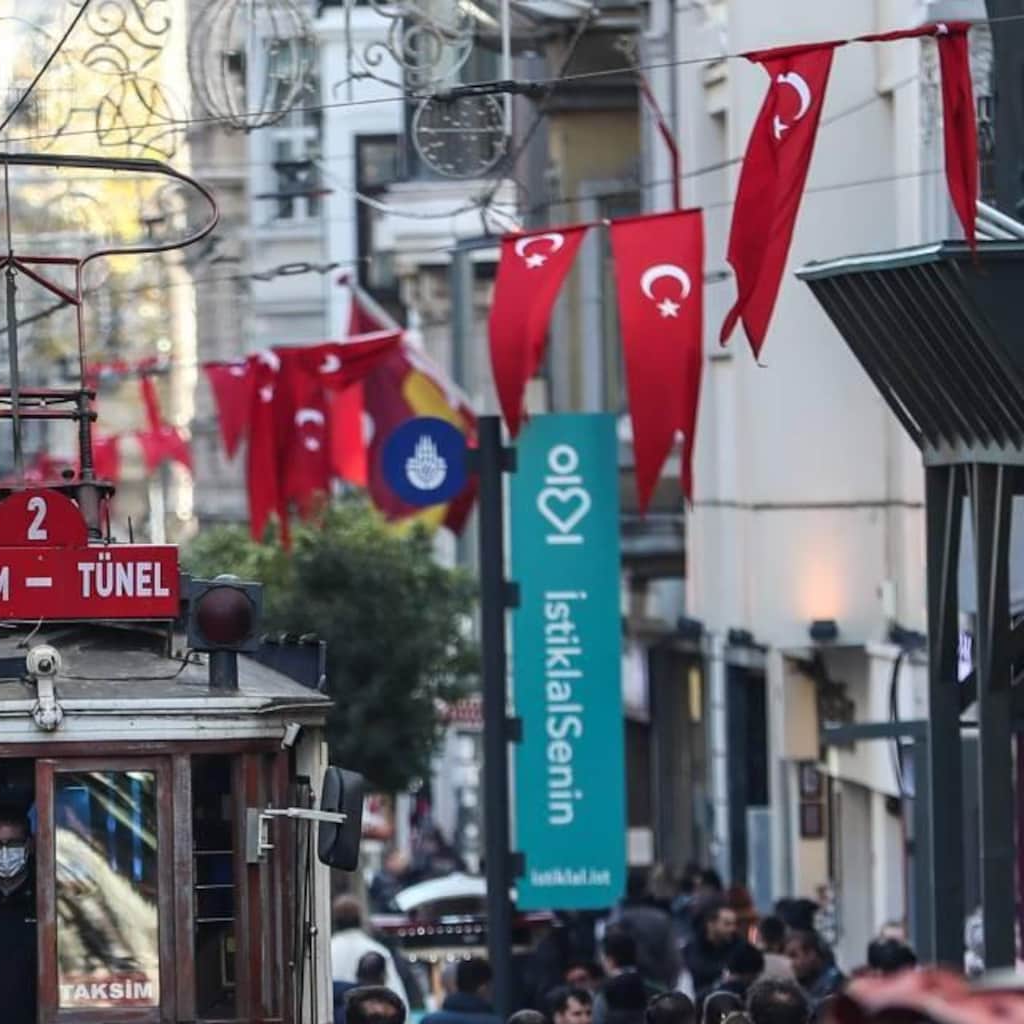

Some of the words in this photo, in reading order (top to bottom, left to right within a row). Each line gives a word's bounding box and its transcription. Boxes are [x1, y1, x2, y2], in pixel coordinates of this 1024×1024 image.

[27, 497, 47, 540] 2
[78, 552, 169, 597] TÜNEL
[59, 979, 152, 1000] TAKSİM
